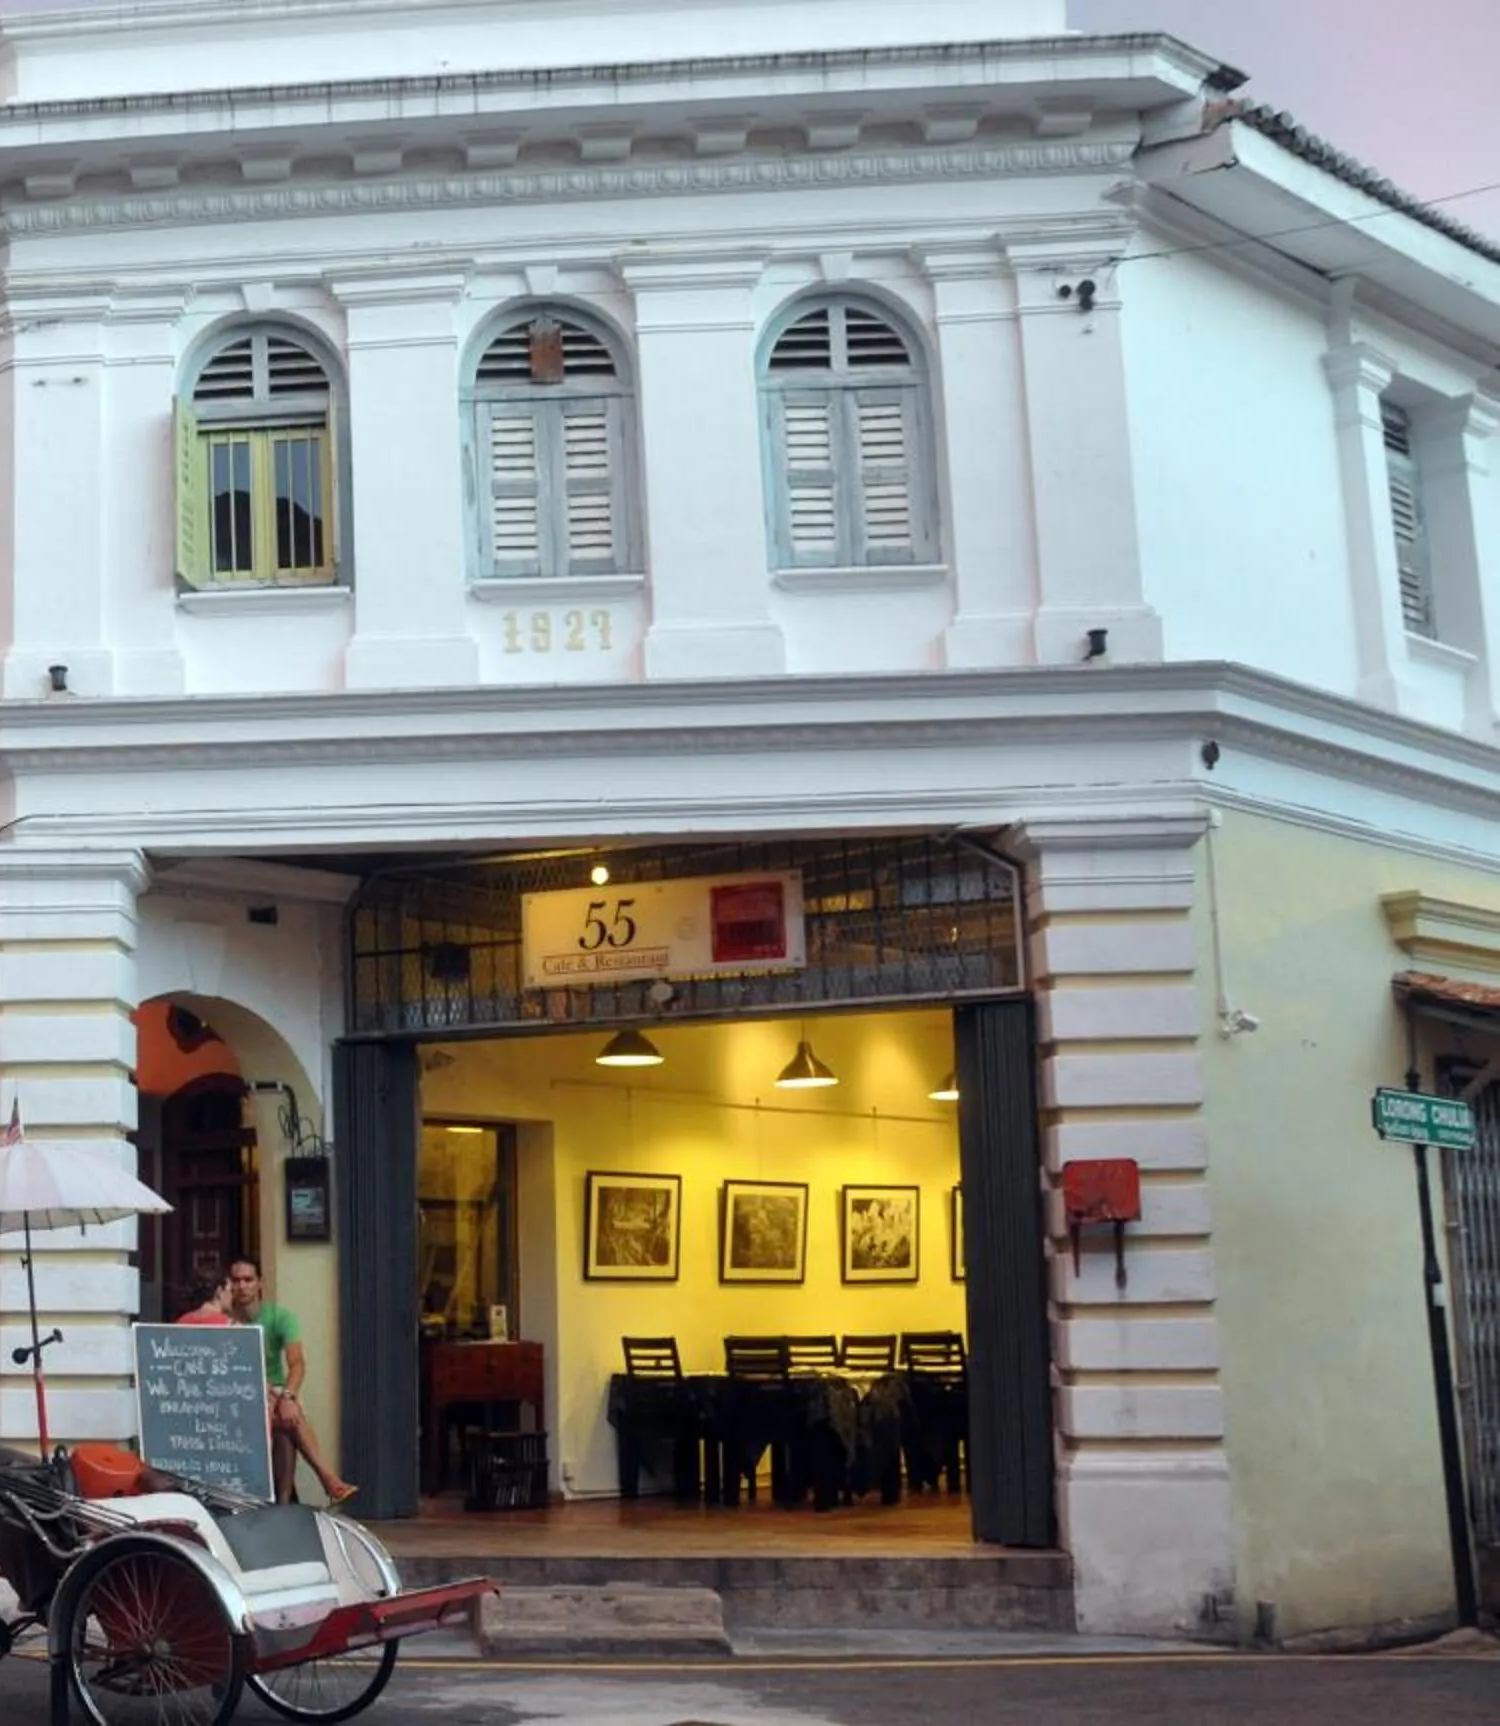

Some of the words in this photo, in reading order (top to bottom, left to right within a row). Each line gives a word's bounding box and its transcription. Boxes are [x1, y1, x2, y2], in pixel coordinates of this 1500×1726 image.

[578, 898, 636, 950] 55
[1381, 1098, 1427, 1122] LORONG
[1431, 1105, 1476, 1128] CHULIA
